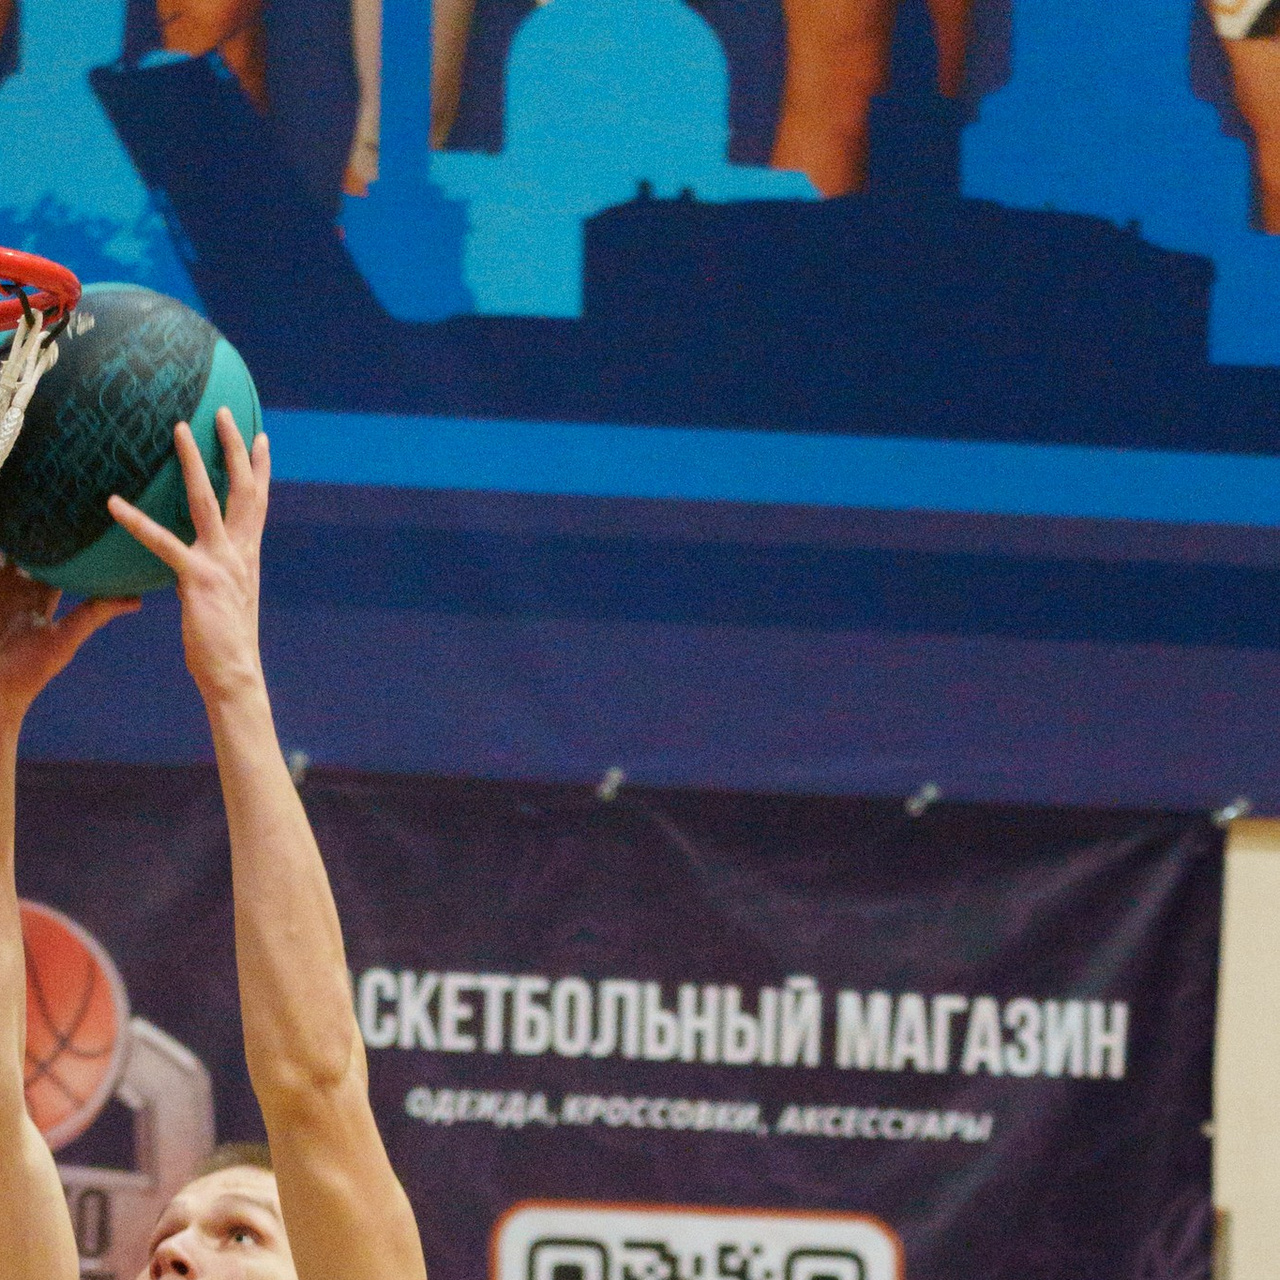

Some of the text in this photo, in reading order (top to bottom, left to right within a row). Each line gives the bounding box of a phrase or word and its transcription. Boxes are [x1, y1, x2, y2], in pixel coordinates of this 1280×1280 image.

[360, 966, 1129, 1080] СКЕТБОЛЬНЫЙ МАГАЗИН
[776, 1103, 995, 1144] АКСЕССУАРЫ
